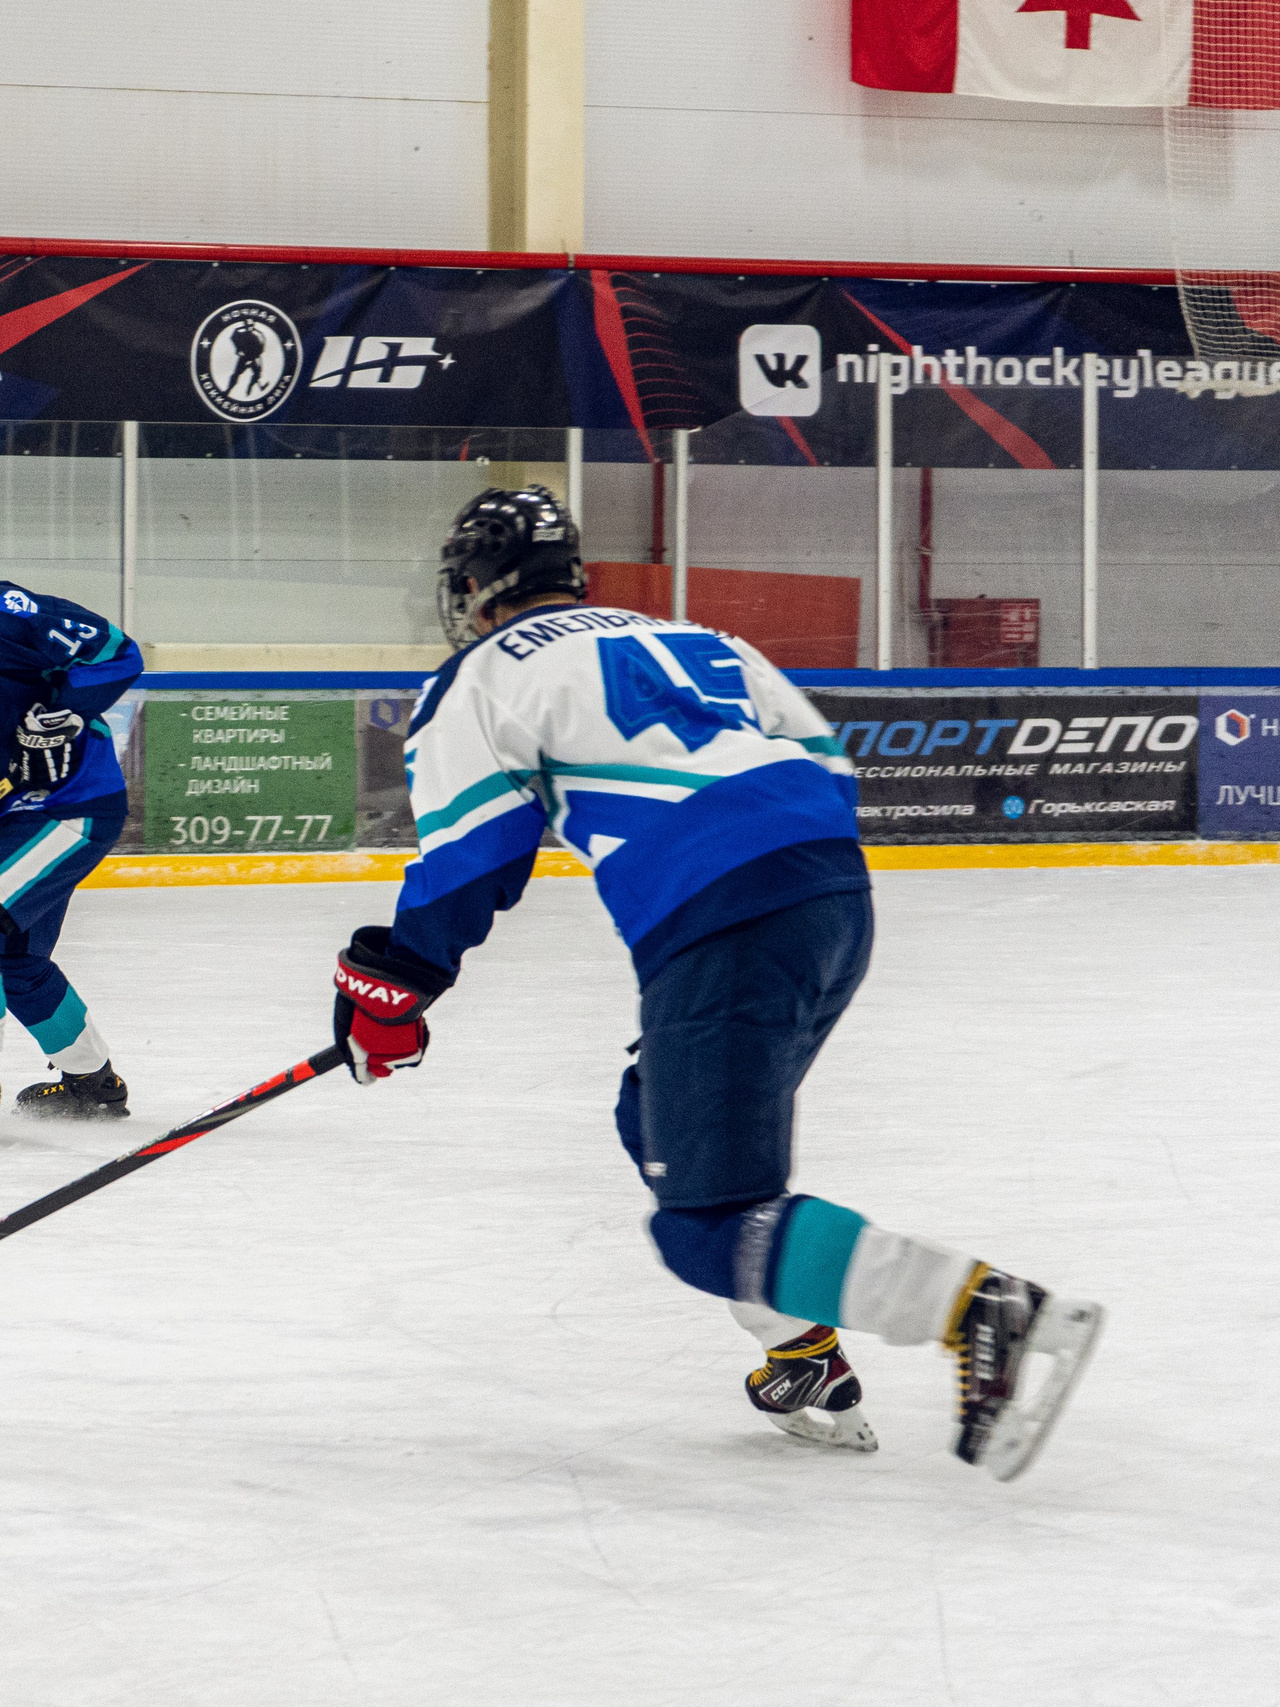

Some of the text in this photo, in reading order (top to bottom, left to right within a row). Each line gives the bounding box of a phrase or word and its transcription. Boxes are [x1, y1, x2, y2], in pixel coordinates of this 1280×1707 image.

[48, 617, 98, 656] 13
[596, 631, 762, 753] 45
[191, 703, 290, 721] СЕМЕЙНЫЕ
[192, 728, 286, 744] КВАРТИРЫ
[854, 760, 1187, 779] ЕССИОНАЛЬНЫЕ МАГАЗИНЫ
[185, 776, 260, 797] ДИЗАЙН
[1028, 798, 1176, 818] Горьковская
[170, 815, 333, 845] 309-77-77
[770, 1378, 792, 1402] CCM
